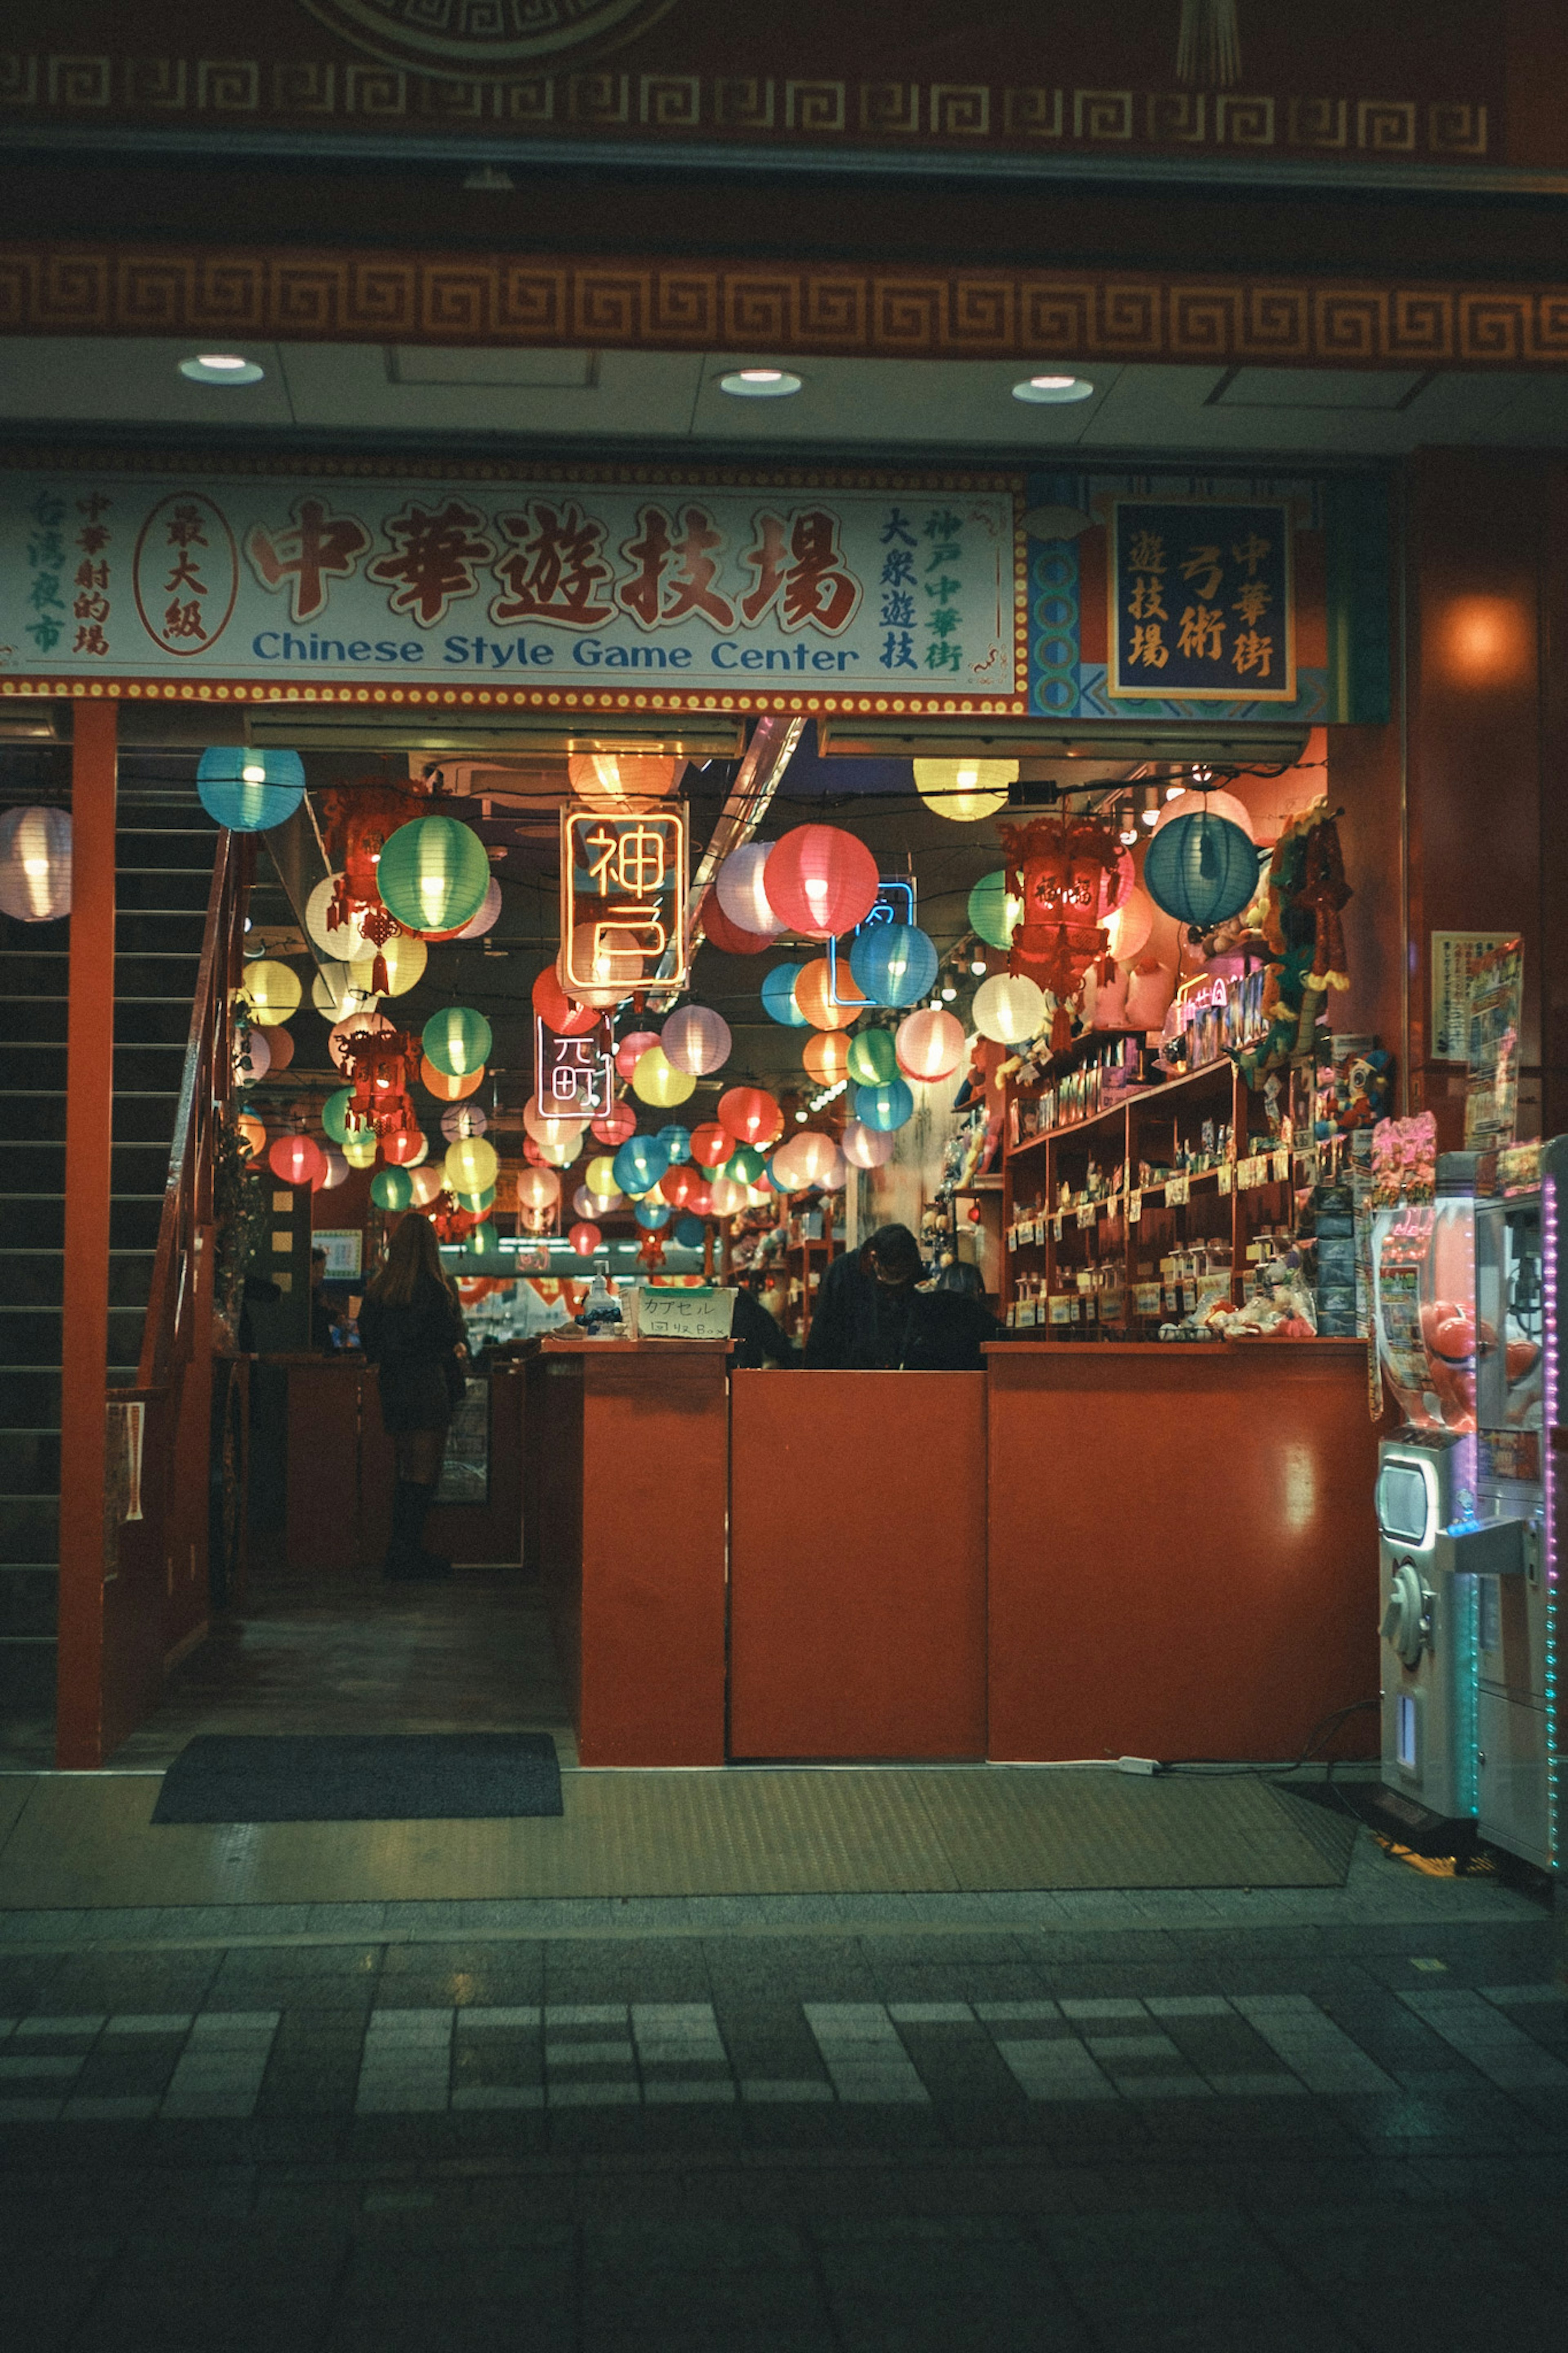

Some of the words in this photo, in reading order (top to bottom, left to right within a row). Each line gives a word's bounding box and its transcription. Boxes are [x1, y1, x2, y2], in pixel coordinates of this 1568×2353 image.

[72, 491, 113, 656] 中華射的場
[164, 505, 208, 640] 最大級
[251, 500, 857, 631] 中華遊技場
[924, 509, 963, 672] 神戸中華街
[1128, 532, 1168, 669] 遊技場
[1177, 545, 1226, 660] 弓術
[1232, 533, 1273, 677] 中華街
[252, 631, 424, 662] Chinese
[443, 636, 555, 668] Style
[572, 638, 692, 667] Game
[711, 641, 860, 671] Center
[586, 824, 665, 969] 神戸
[645, 1299, 715, 1316] カプセル
